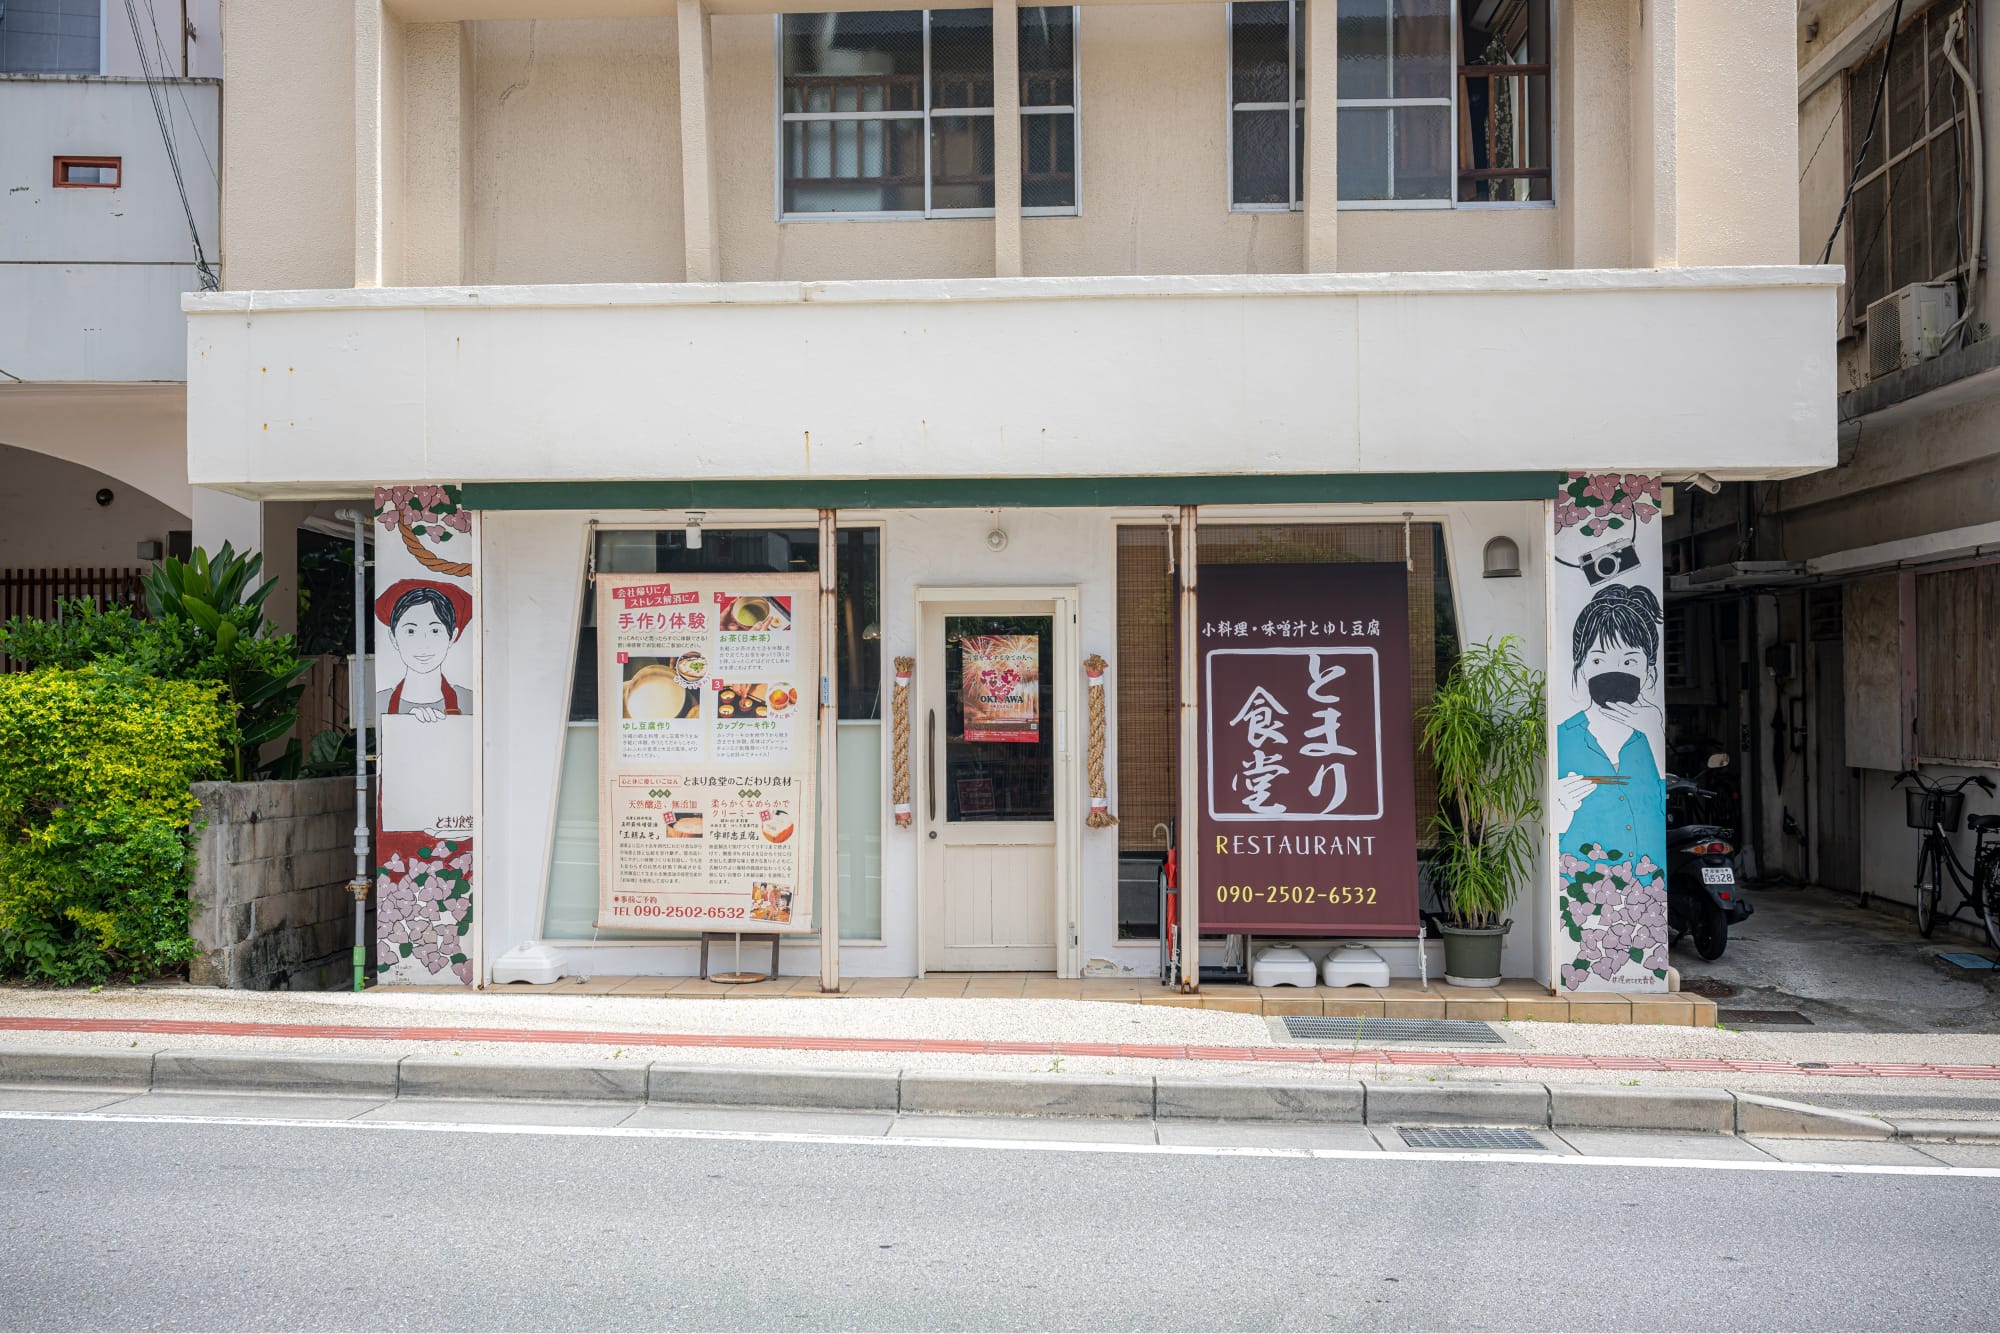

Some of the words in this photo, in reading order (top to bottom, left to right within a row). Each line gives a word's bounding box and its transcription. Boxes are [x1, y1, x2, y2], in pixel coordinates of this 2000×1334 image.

[618, 611, 706, 630] 手作り体験
[1202, 620, 1381, 638] 小料理・味噌汁とゆし豆腐
[714, 681, 721, 689] 3
[622, 722, 671, 731] ゆし豆腐作り
[716, 721, 776, 730] カップケーキ作り
[1299, 653, 1358, 815] とまり
[1229, 685, 1290, 814] 食堂
[683, 776, 792, 787] とまり食堂のこだわり食材
[711, 799, 790, 808] 柔らかくなめらかで
[712, 809, 755, 818] クリーミー
[435, 815, 474, 829] とまり食堂
[1216, 835, 1377, 855] RESTAURANT
[1216, 885, 1377, 905] 090-2502-6532
[613, 906, 630, 916] TEL
[633, 905, 745, 919] 090-2502-6532
